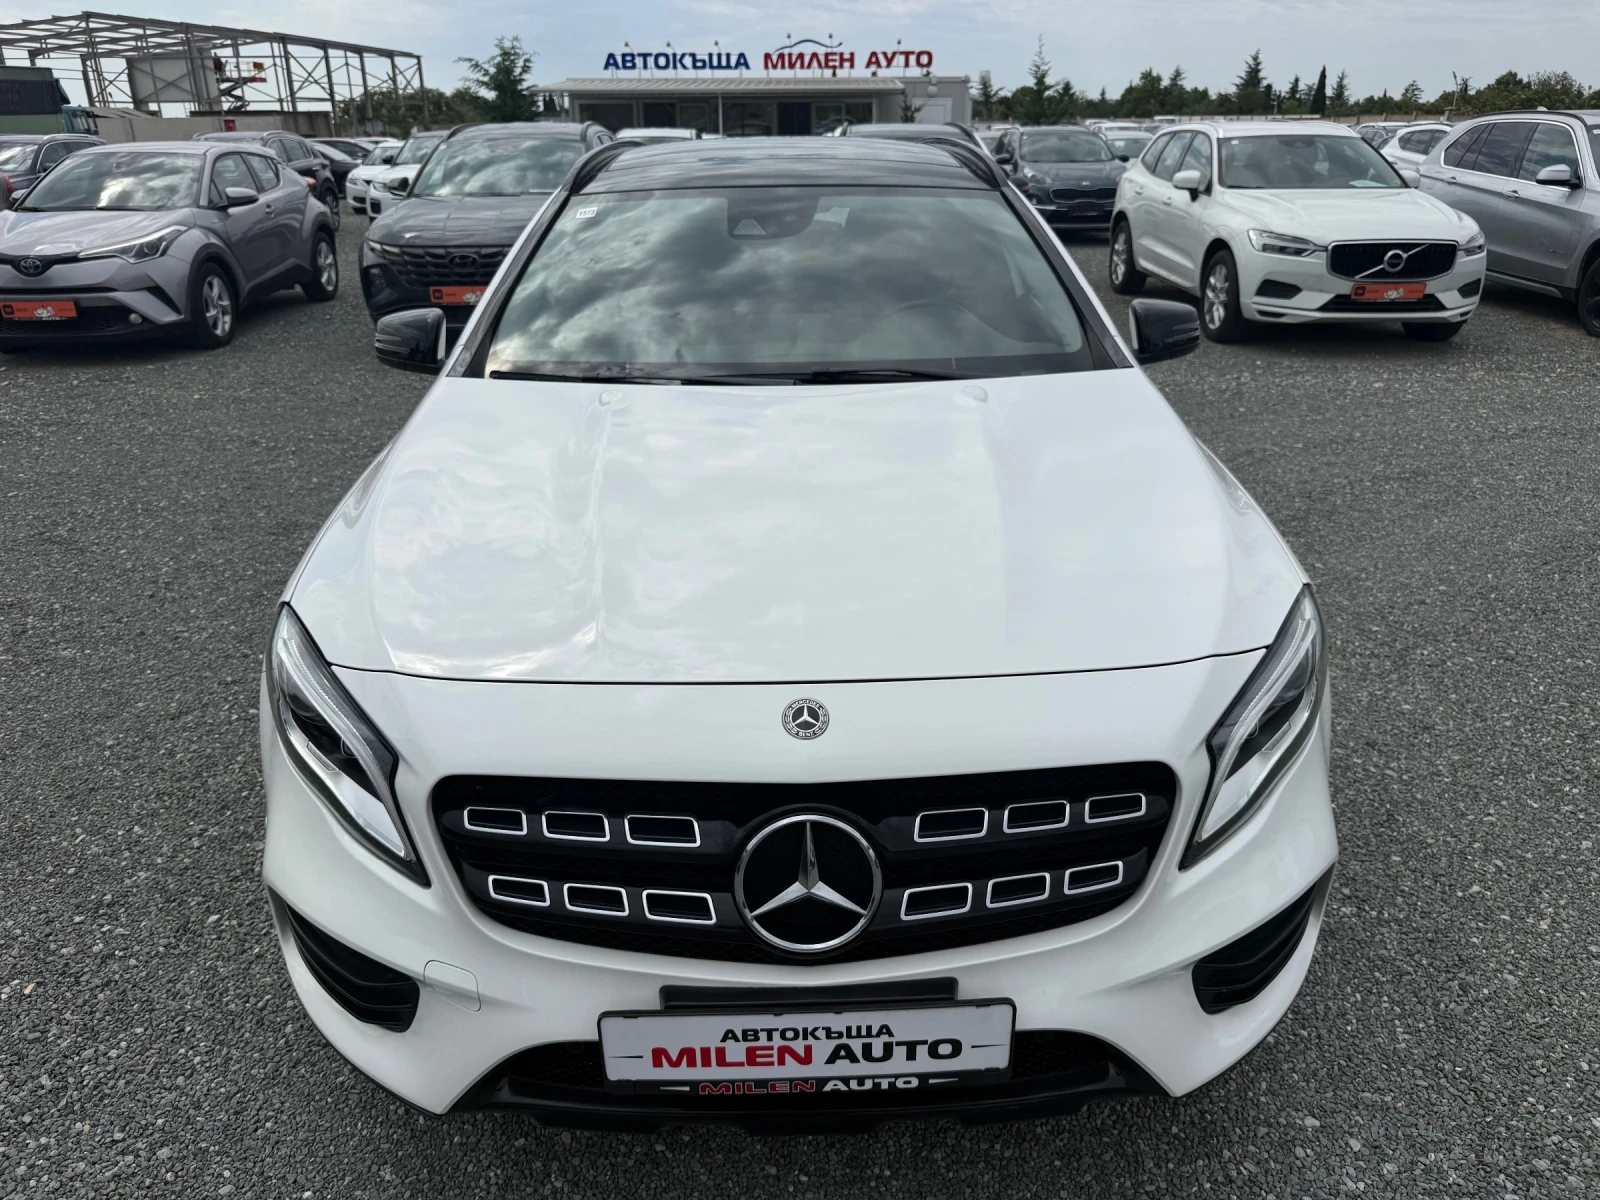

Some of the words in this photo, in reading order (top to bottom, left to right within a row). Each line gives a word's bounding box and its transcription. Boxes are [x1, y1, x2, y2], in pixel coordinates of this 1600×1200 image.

[763, 52, 856, 70] МИЛЕН
[865, 50, 934, 69] АУТО
[651, 1044, 813, 1068] MILEN
[824, 1038, 963, 1065] AUTO
[699, 1080, 817, 1096] MILEN
[821, 1076, 920, 1092] AUTO
